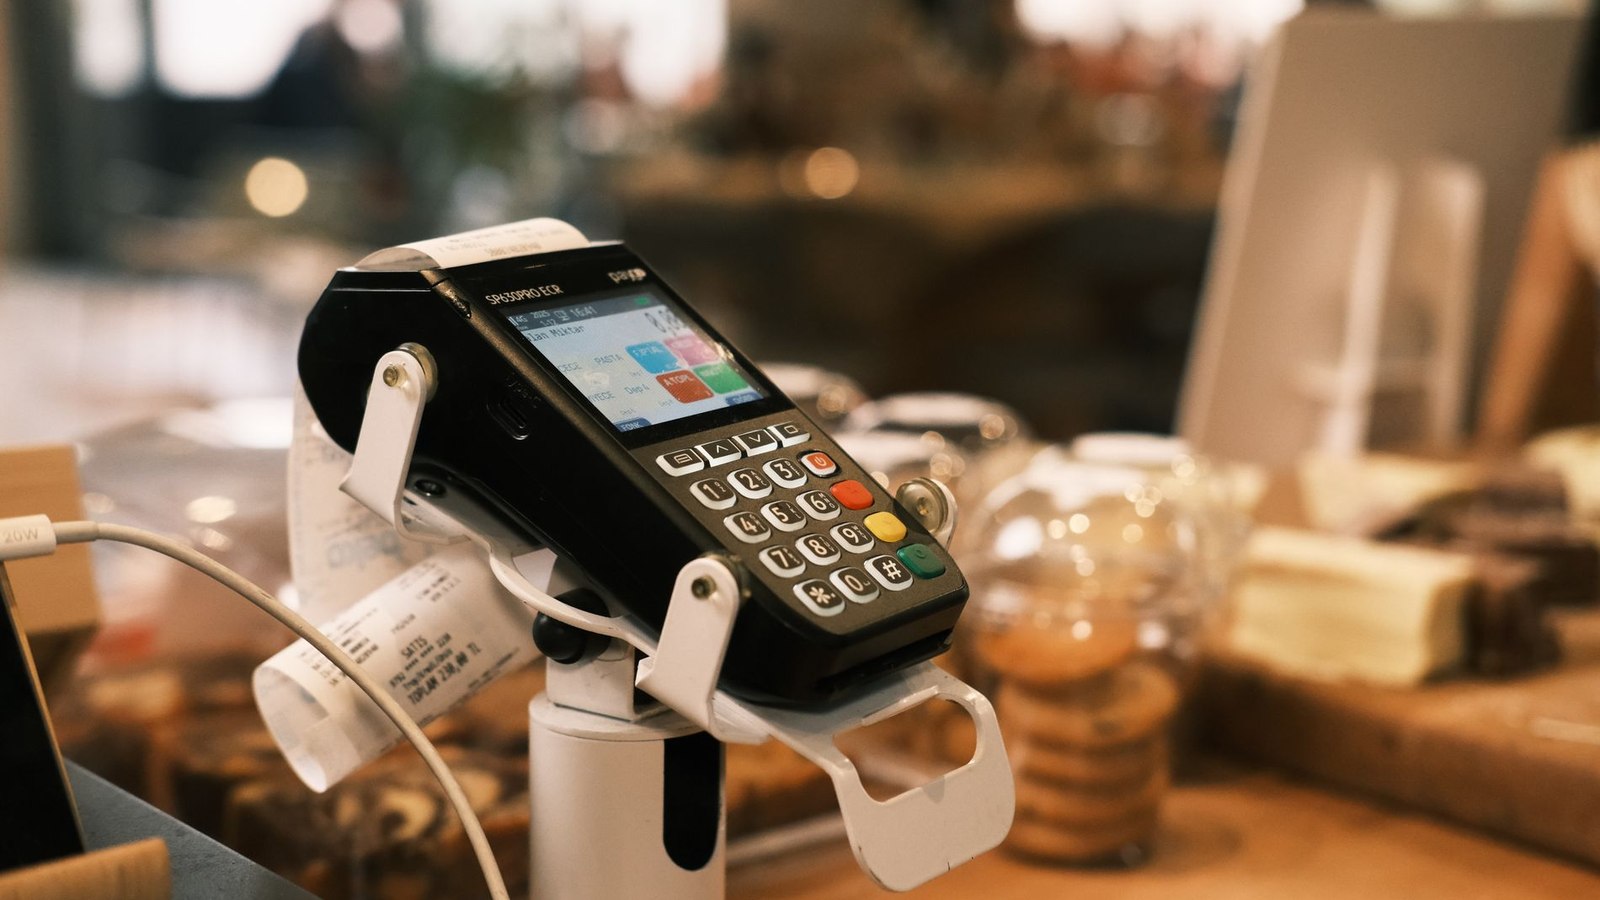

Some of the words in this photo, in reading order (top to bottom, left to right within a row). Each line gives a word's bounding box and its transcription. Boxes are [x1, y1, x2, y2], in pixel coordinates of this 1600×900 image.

[485, 288, 541, 305] SP630PRO
[540, 284, 564, 297] ECR
[773, 463, 793, 479] 3
[739, 473, 760, 490] 2
[703, 483, 720, 500] 1
[810, 495, 828, 511] 6
[771, 507, 789, 523] 5
[740, 517, 758, 533] 4
[842, 527, 860, 544] 9
[808, 539, 828, 556] 8
[771, 550, 790, 568] 7
[882, 559, 902, 580] #
[844, 574, 864, 592] 0
